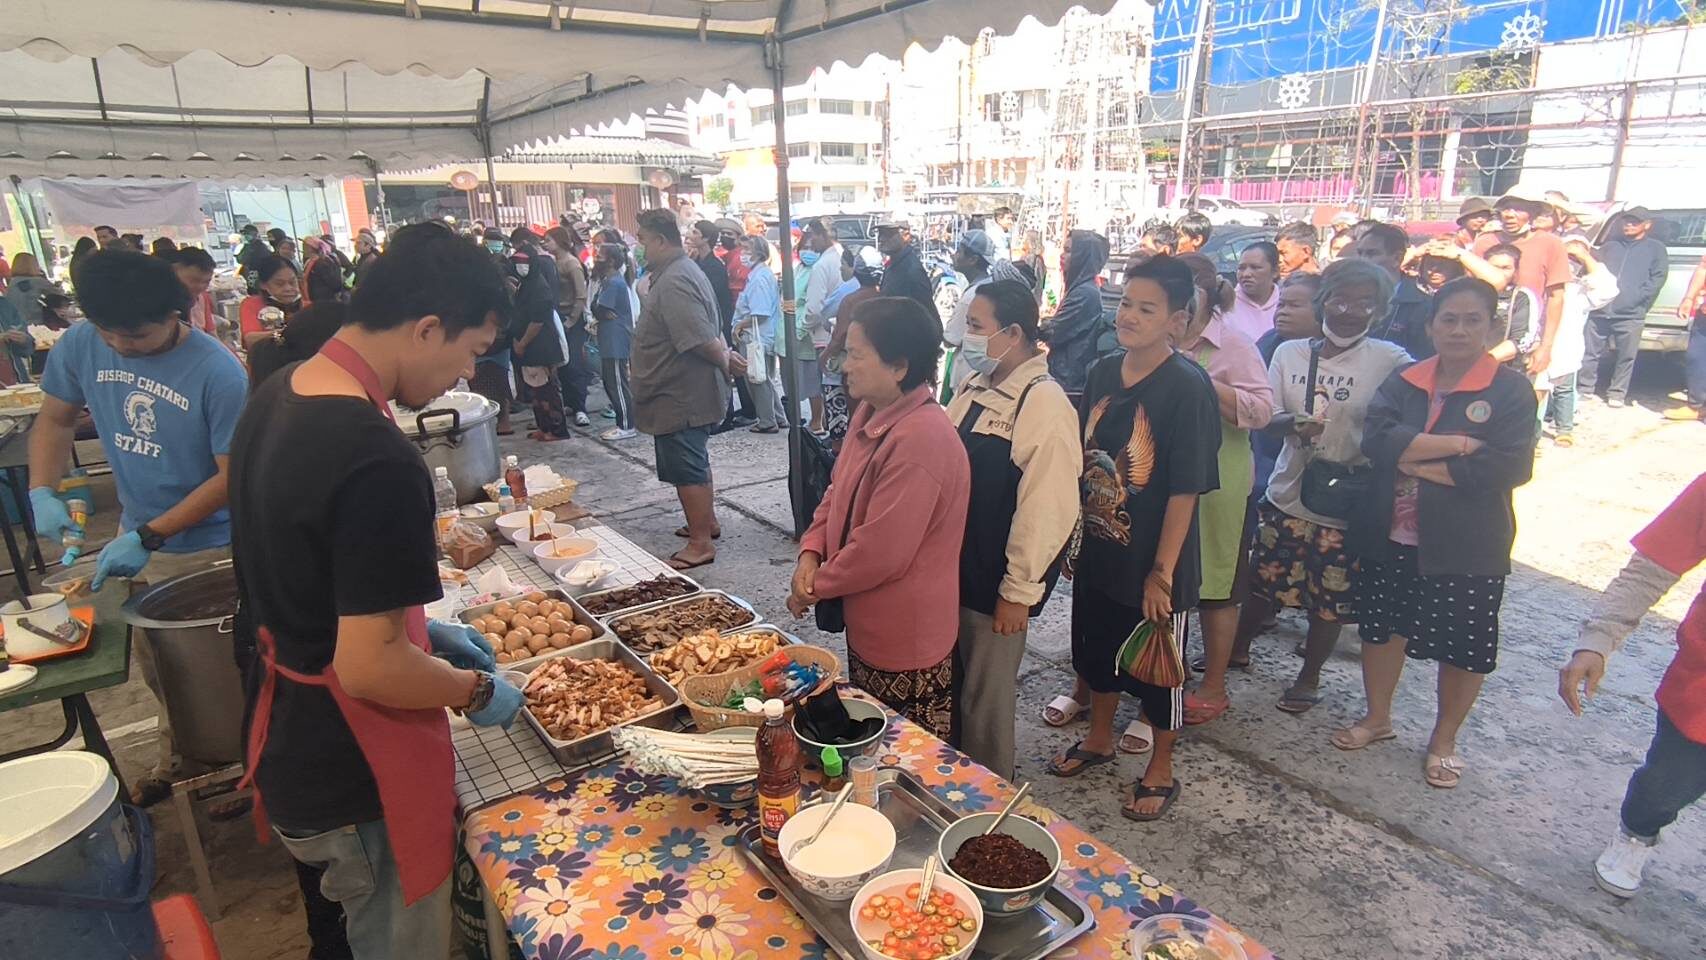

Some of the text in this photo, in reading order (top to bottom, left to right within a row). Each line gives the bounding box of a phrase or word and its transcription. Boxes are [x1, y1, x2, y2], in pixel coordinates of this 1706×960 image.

[96, 370, 190, 411] BISHOP CHATARD
[114, 433, 162, 458] STAFF
